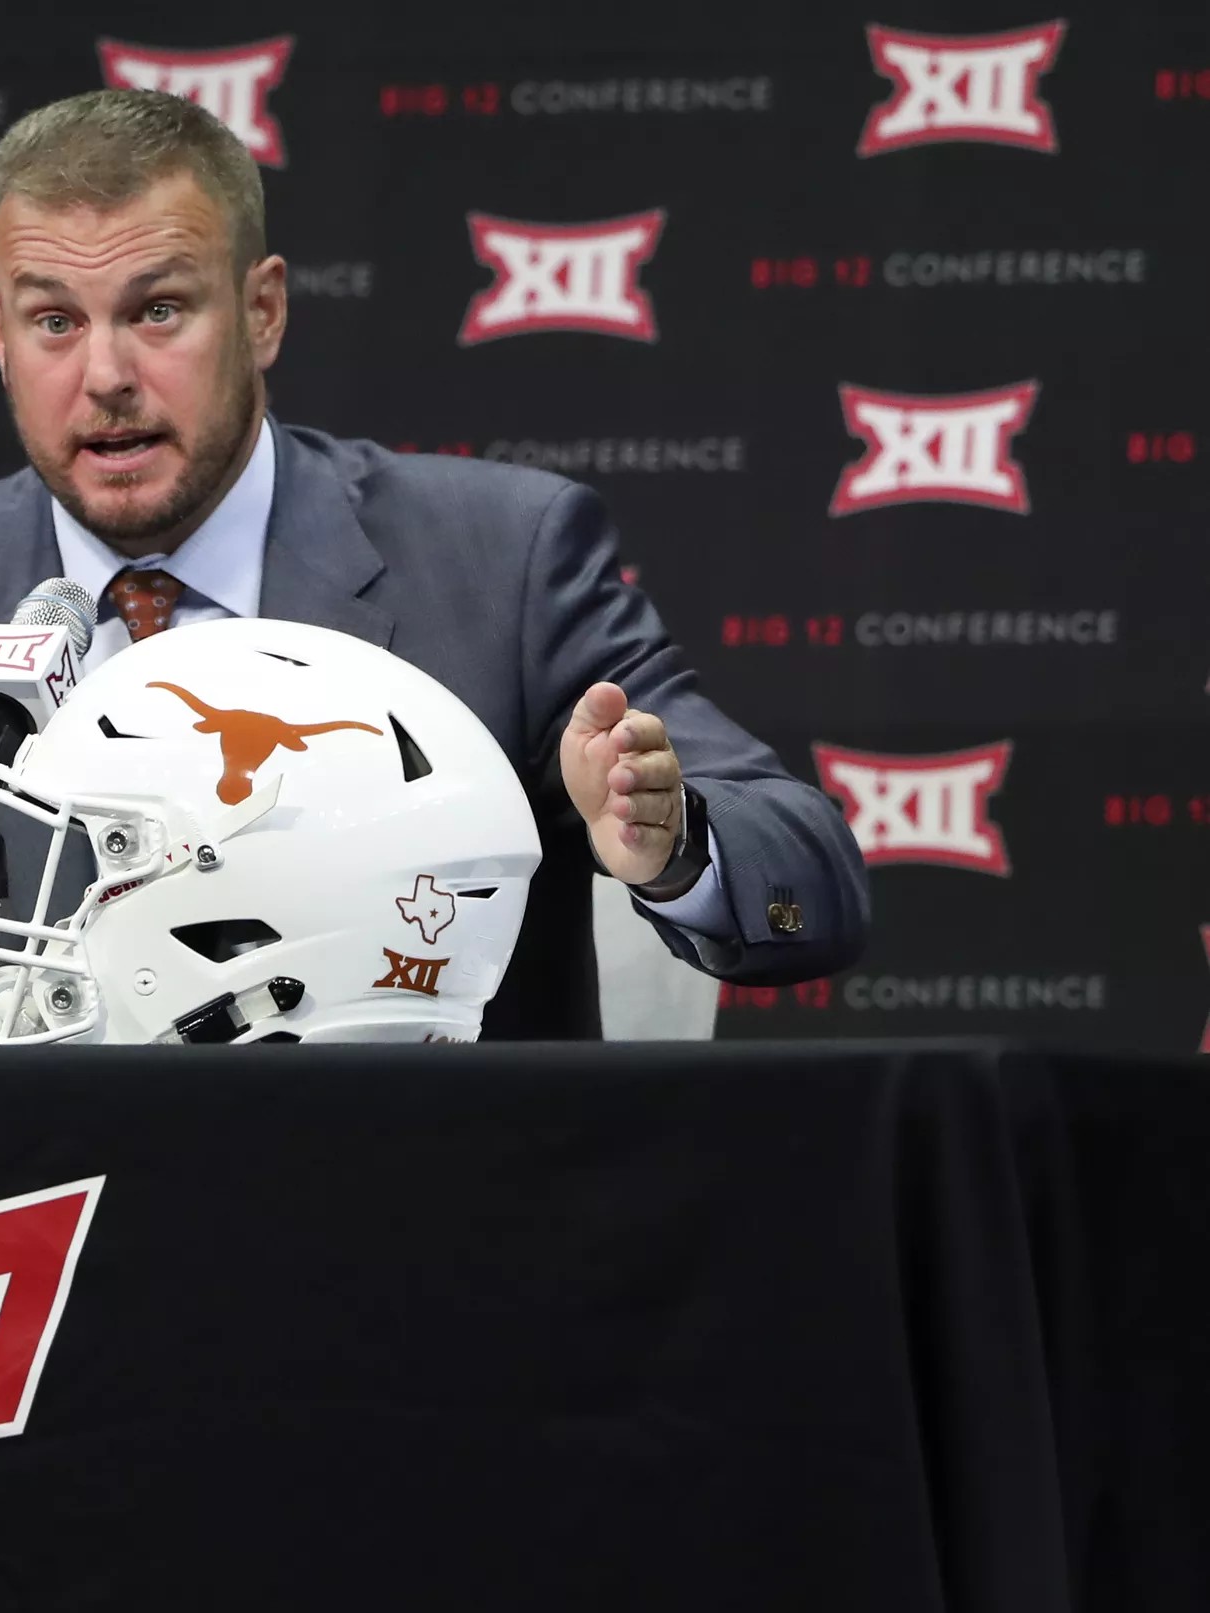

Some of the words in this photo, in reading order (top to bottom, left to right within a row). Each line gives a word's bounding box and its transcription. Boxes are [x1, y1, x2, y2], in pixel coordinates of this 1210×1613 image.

[380, 84, 446, 116] BIG
[463, 84, 500, 116] 12
[510, 77, 773, 115] CONFERENCE
[874, 35, 1050, 141] XII
[473, 224, 650, 330] XII
[751, 257, 819, 289] BIG
[835, 257, 872, 288] 12
[883, 249, 1146, 287] CONFERENCE
[846, 395, 1024, 501] XII
[1127, 432, 1194, 464] BIG
[721, 614, 789, 647] BIG
[806, 614, 844, 647] 12
[855, 610, 1119, 646] CONFERENCE
[827, 756, 997, 861] XII
[1104, 795, 1171, 826] BIG
[372, 947, 450, 997] XII
[843, 975, 1107, 1010] CONFERENCE
